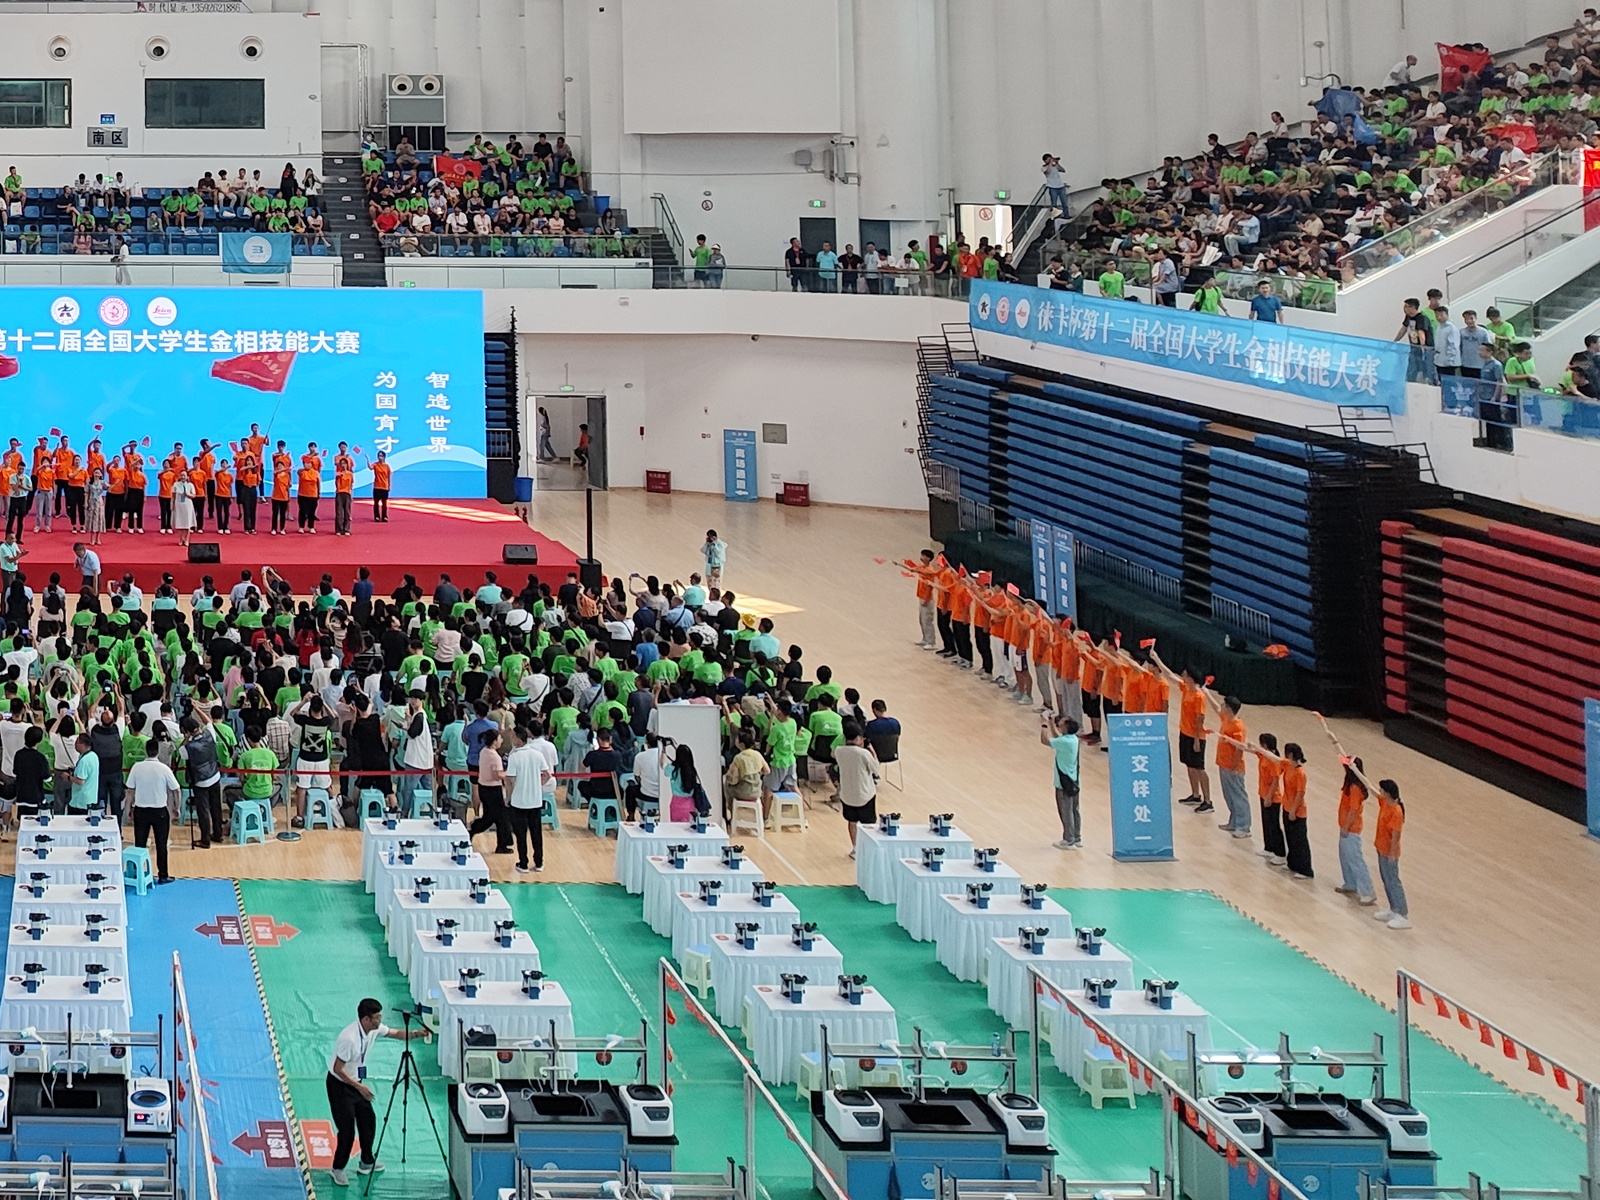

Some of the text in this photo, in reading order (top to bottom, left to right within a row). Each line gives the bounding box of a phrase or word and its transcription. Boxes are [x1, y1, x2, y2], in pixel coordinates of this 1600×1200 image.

[93, 130, 123, 145] 南区
[1037, 301, 1381, 396] 徕卡杯第十二届全国大学生金相技能大赛
[373, 371, 399, 454] 为国育才
[425, 371, 451, 454] 智造世界
[1131, 755, 1152, 840] 交样处一
